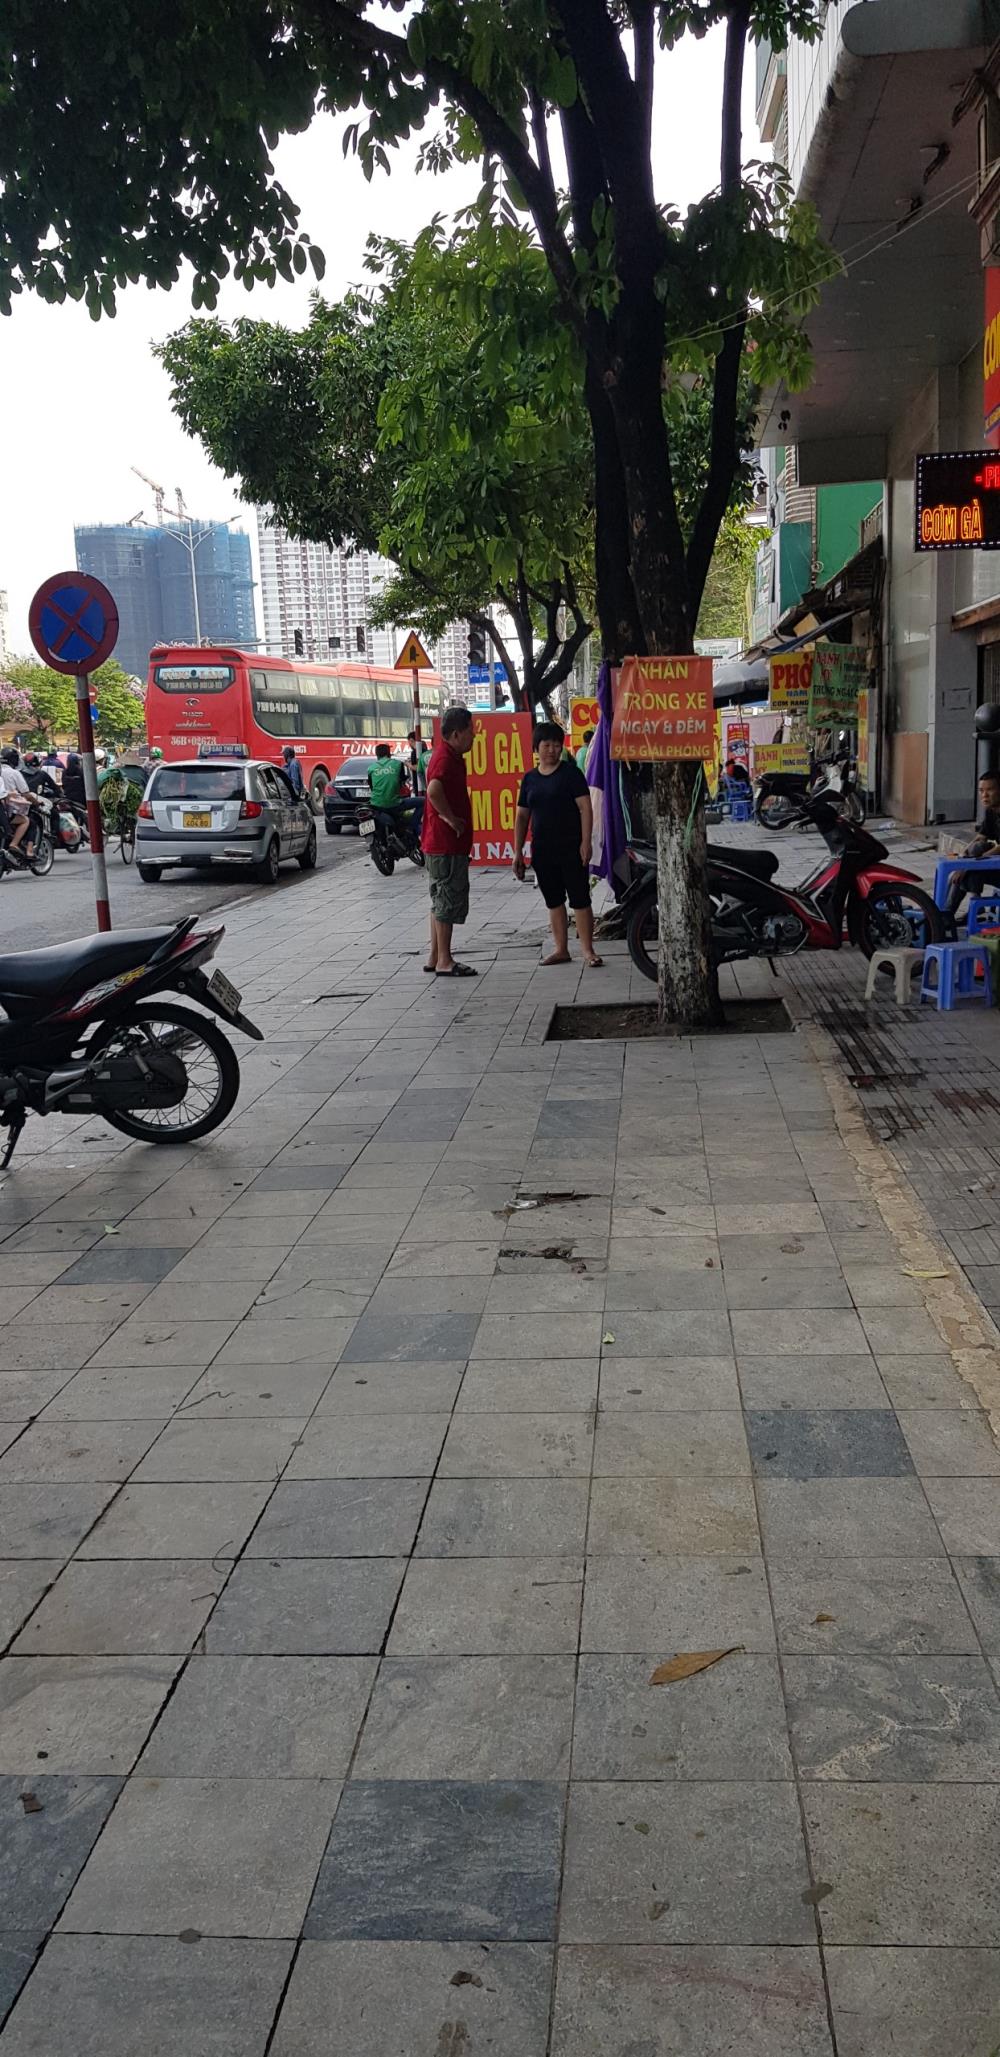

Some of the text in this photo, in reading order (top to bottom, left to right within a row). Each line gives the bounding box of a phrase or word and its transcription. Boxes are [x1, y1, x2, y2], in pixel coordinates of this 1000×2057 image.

[921, 499, 982, 541] CƠM GÀ
[685, 692, 707, 710] XE
[620, 717, 706, 734] NGÀY & ĐÊM
[494, 723, 524, 774] GÀ
